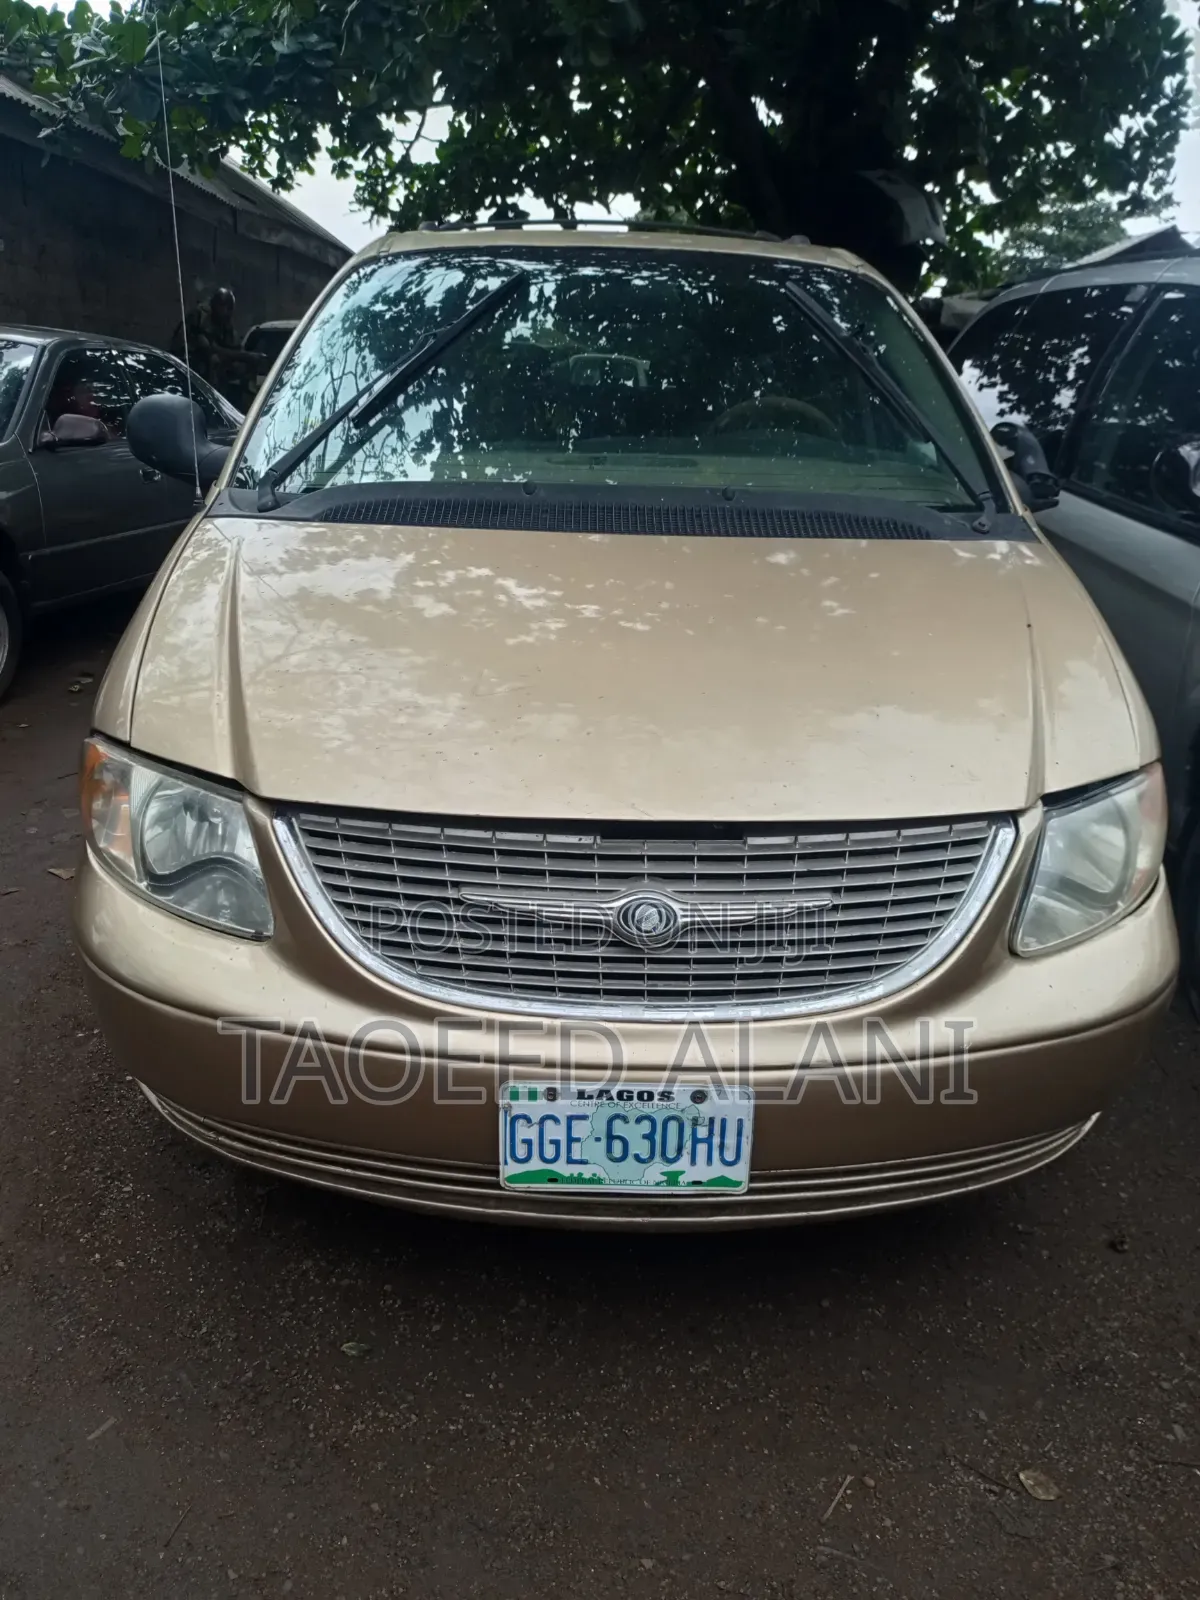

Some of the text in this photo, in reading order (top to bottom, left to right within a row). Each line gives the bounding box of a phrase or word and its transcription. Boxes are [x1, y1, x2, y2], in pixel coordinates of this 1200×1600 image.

[576, 1089, 676, 1102] LAGOS
[570, 1100, 605, 1108] CENTRE
[607, 1101, 621, 1109] OF
